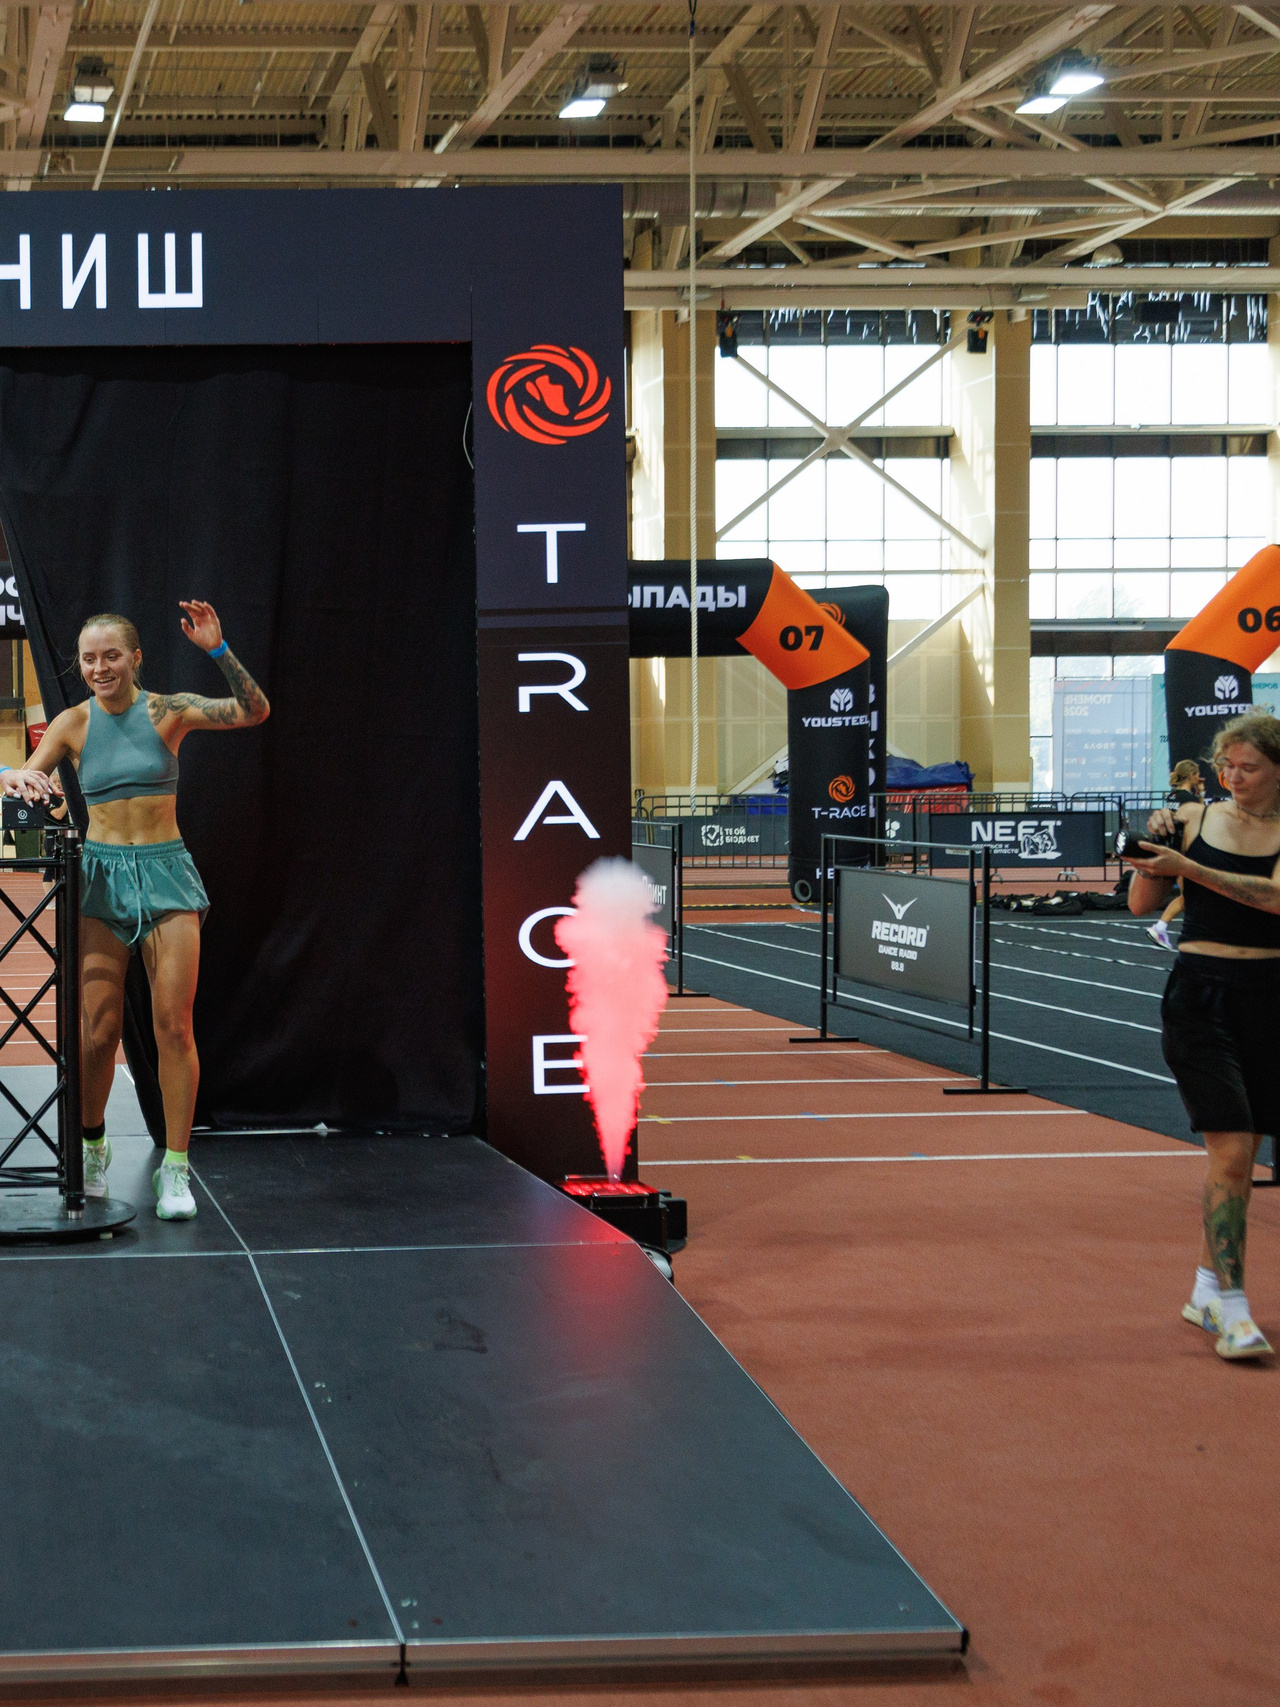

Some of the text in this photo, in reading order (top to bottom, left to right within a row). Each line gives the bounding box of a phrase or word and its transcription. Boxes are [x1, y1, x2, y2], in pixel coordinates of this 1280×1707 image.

[628, 585, 747, 612] ПАДЫ
[1237, 605, 1280, 633] 06
[779, 625, 824, 651] 07
[801, 715, 870, 729] YOUSTEEL
[811, 804, 867, 819] T-RACE
[871, 920, 928, 948] RECORD
[898, 948, 918, 960] RADIO
